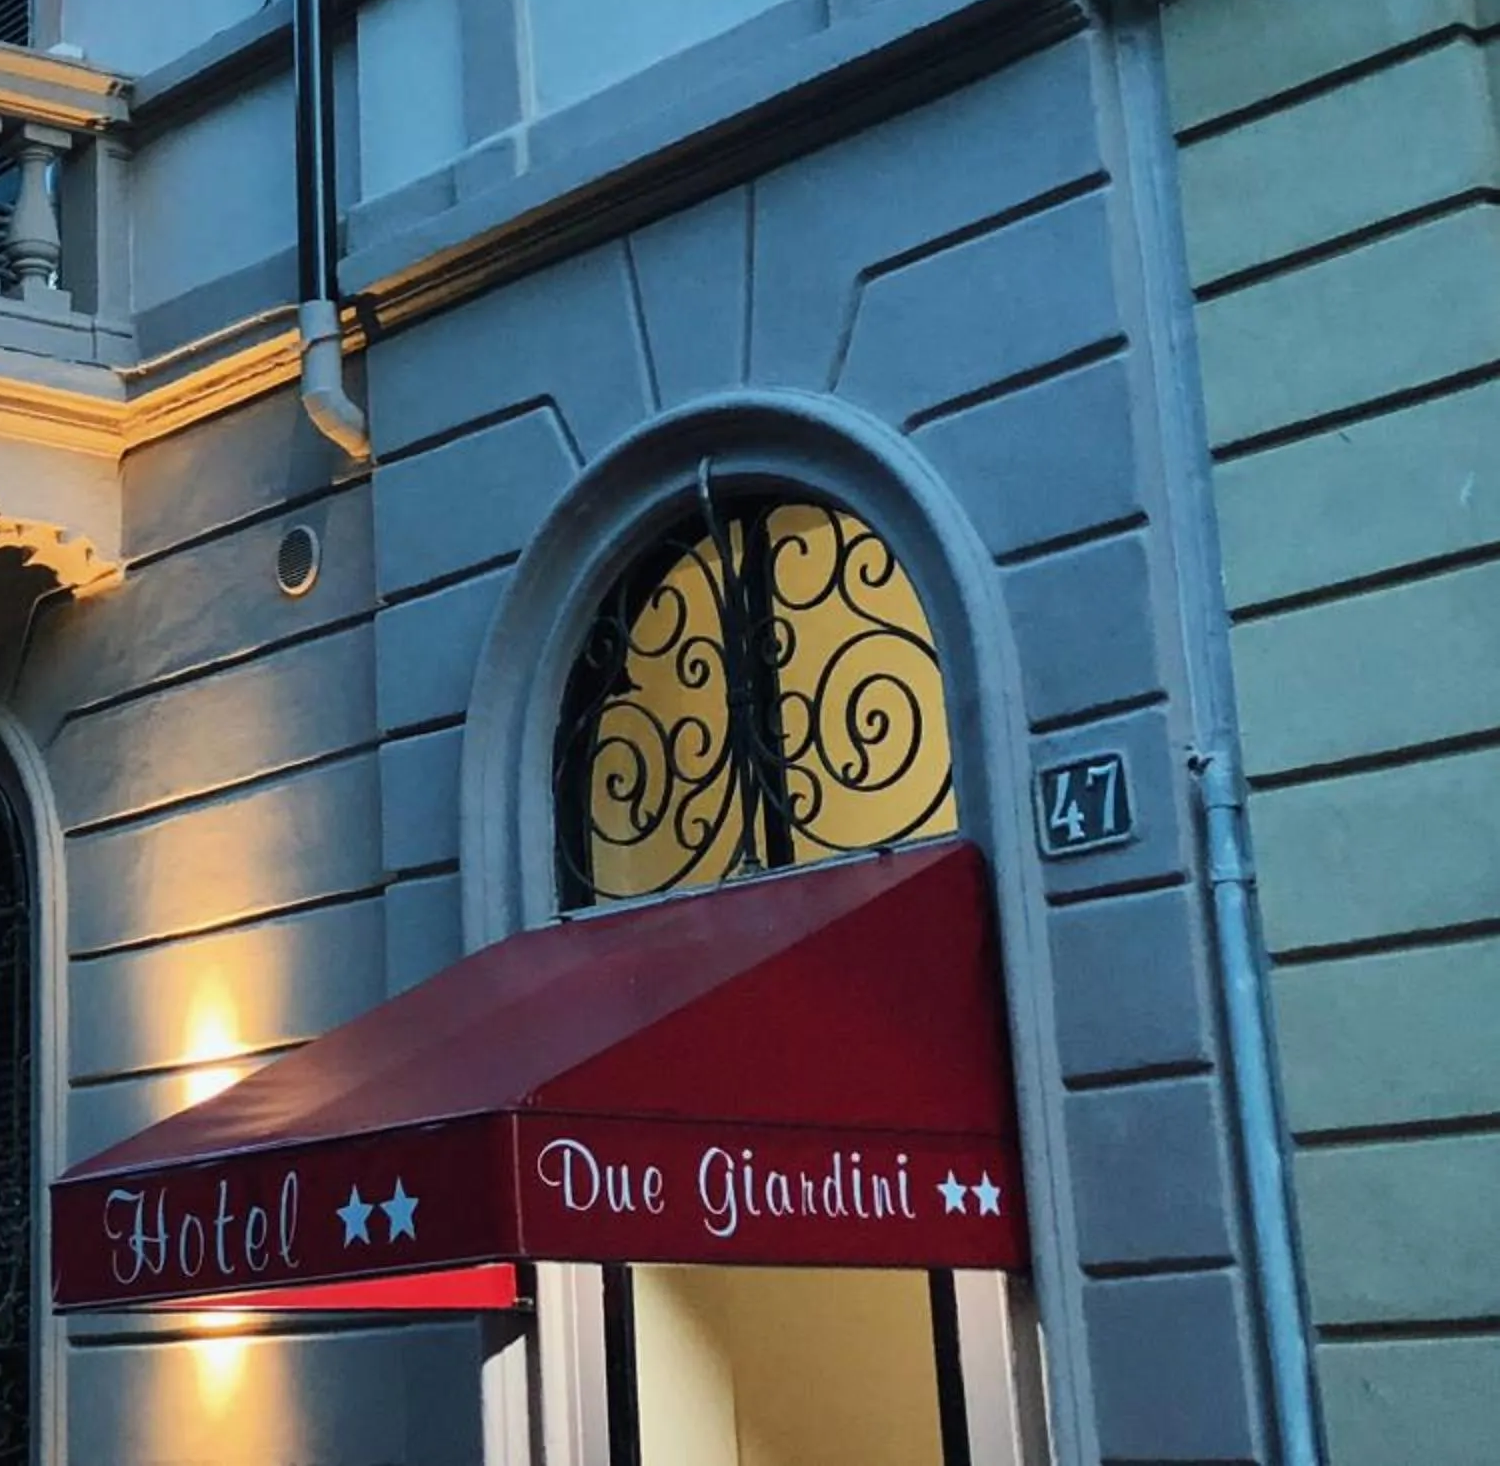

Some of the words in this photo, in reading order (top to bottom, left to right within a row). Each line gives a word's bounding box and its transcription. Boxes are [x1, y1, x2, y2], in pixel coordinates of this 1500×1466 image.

[1051, 760, 1118, 841] 47
[103, 1170, 300, 1285] Hotel
[537, 1138, 665, 1214] Due
[700, 1146, 916, 1236] Giardini
